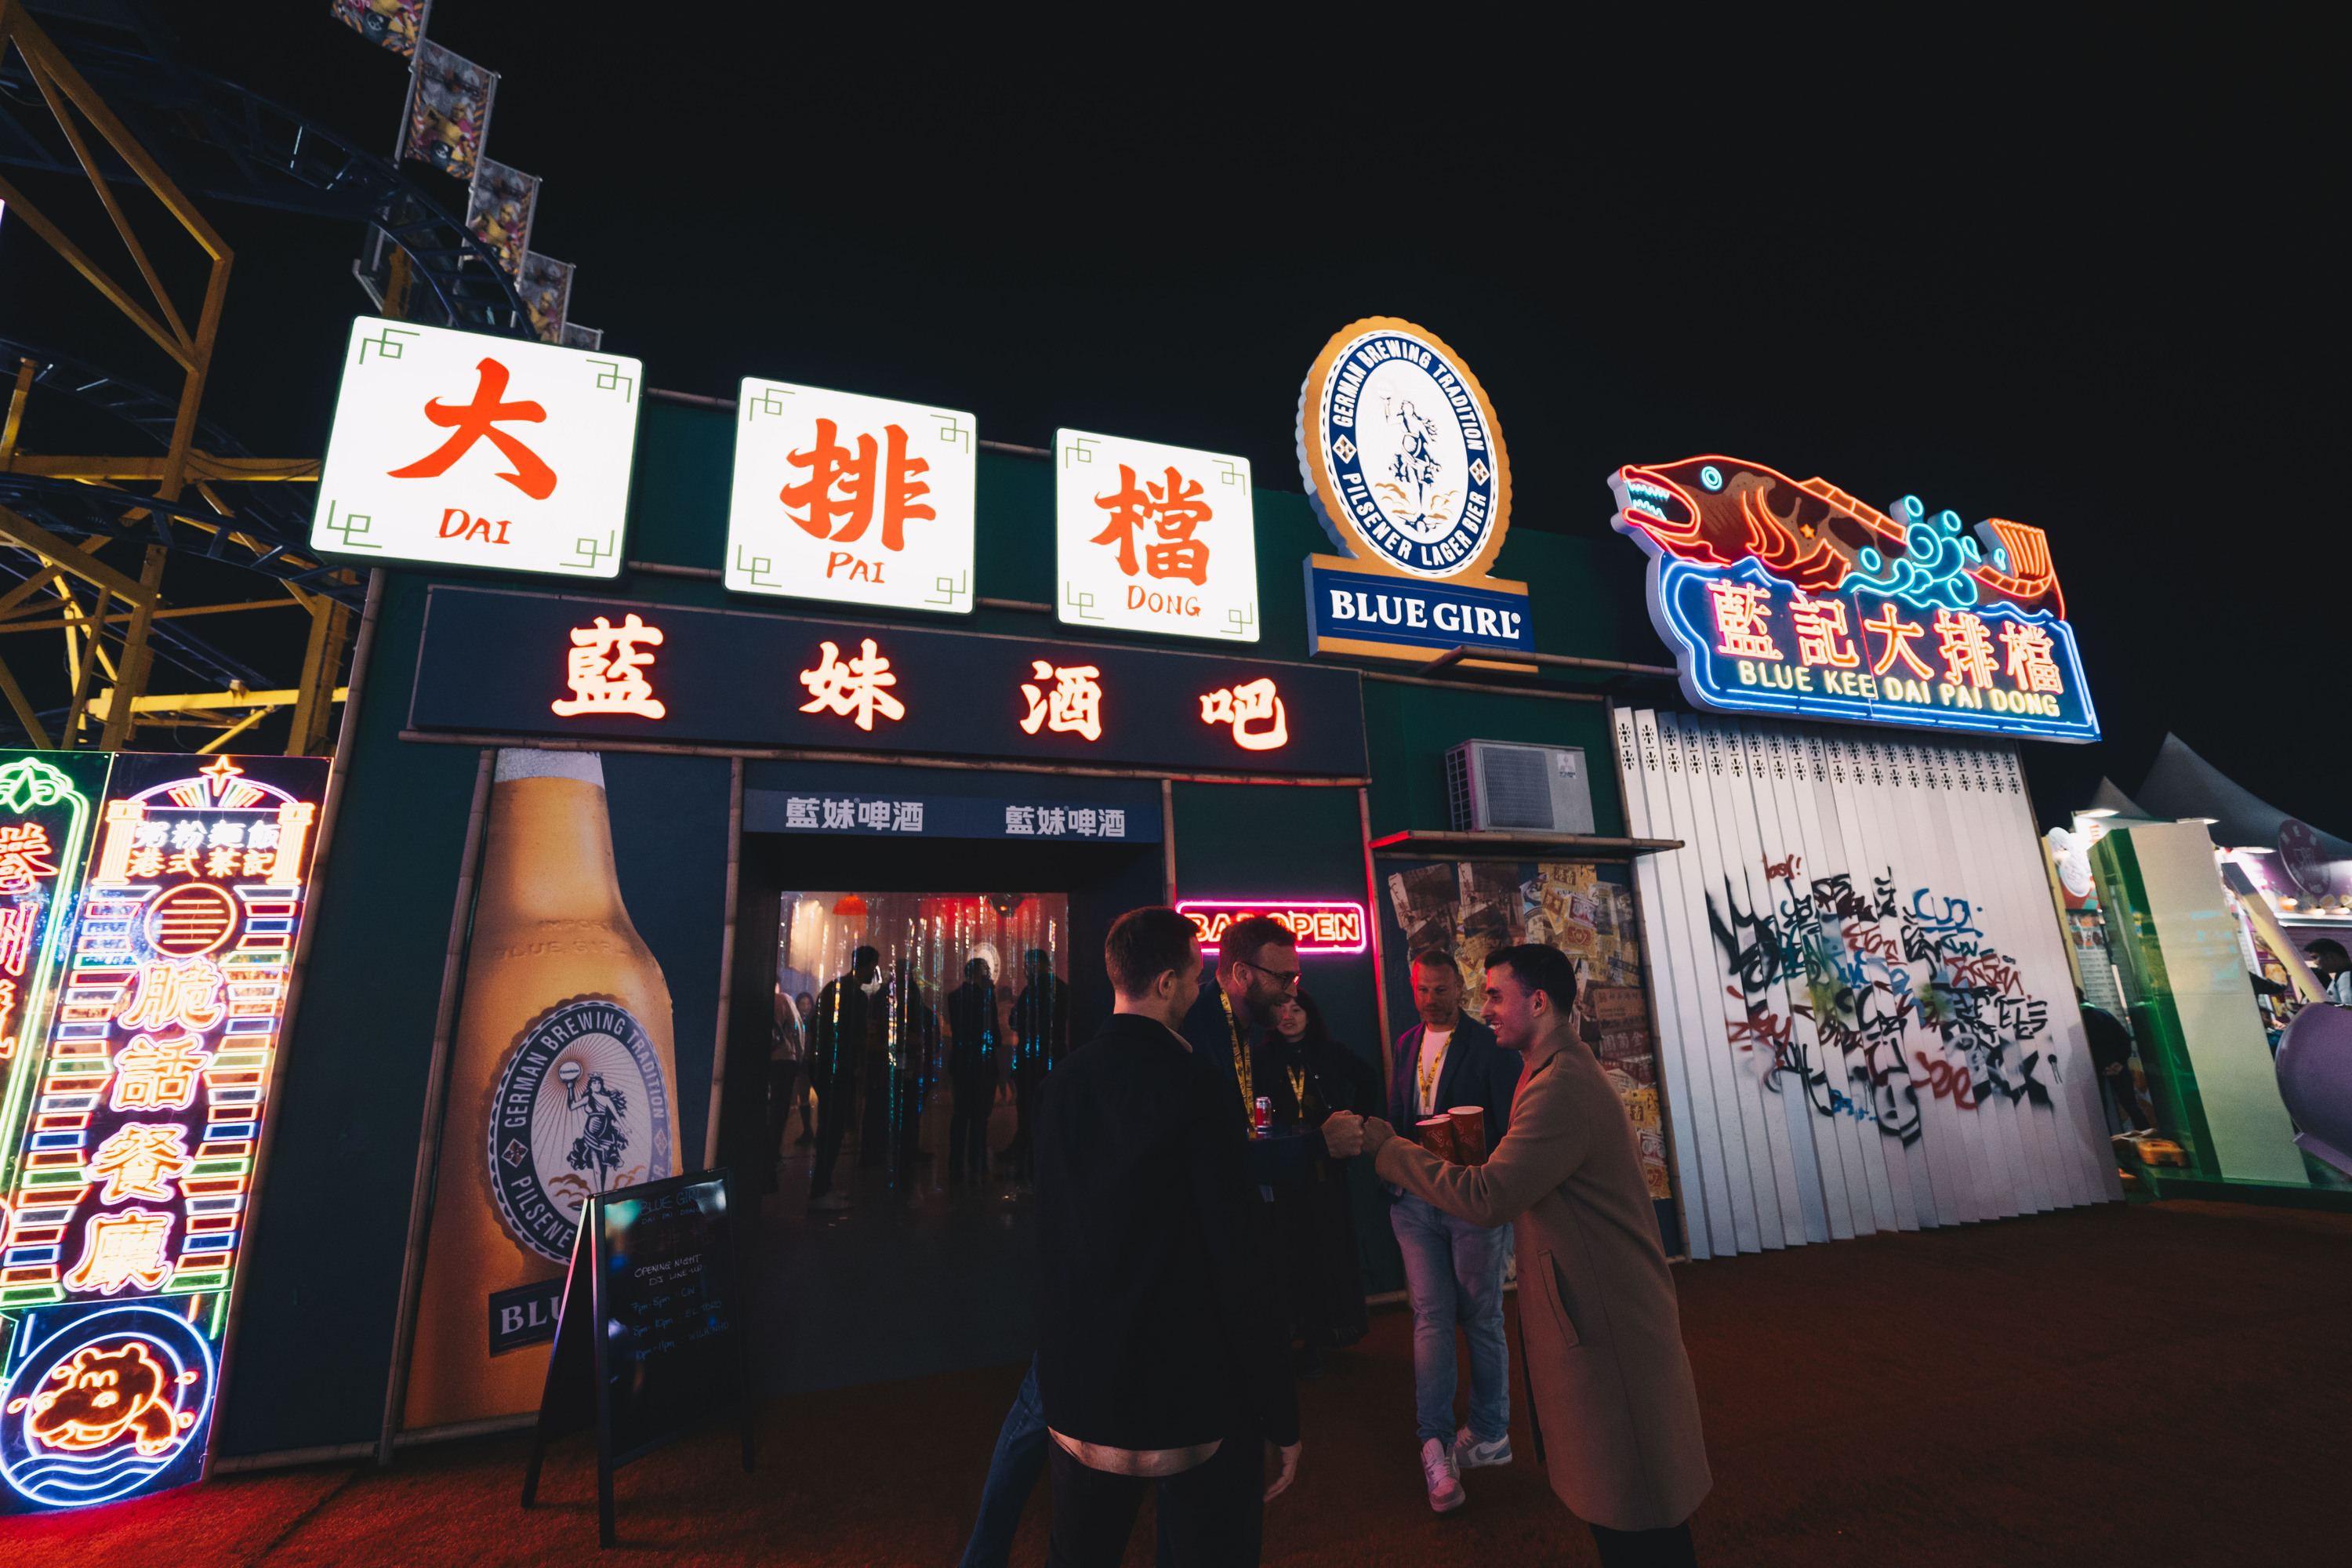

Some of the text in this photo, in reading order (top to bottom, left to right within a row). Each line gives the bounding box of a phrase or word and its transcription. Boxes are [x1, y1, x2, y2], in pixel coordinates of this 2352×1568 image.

[1333, 339, 1485, 451] GERMAN BREWING TRADITION
[386, 357, 557, 500] 大
[779, 417, 937, 552] 排
[434, 507, 512, 545] DAI
[1089, 463, 1213, 586] 檔
[1342, 473, 1486, 566] PILSENER LAGER BIER
[826, 550, 886, 584] PAI
[1126, 585, 1201, 618] DONG
[1330, 590, 1428, 629] BLUE
[1707, 579, 2063, 695] 藍記大排檔
[551, 613, 1288, 750] 藍妹酒吧
[1738, 660, 2060, 717] BLUE KEE DAI PAI DONG
[125, 847, 275, 878] 港式茶記
[1184, 913, 1255, 942] BA
[504, 1011, 665, 1128] GERMAN BREWING TRADITION
[64, 956, 227, 1295] 脆話餐廳
[511, 1175, 575, 1249] PILSENE
[639, 1194, 673, 1216] BLUE
[633, 1254, 703, 1279] OPENING NIGHT
[648, 1276, 663, 1287] DJ
[500, 1295, 560, 1335] BLU
